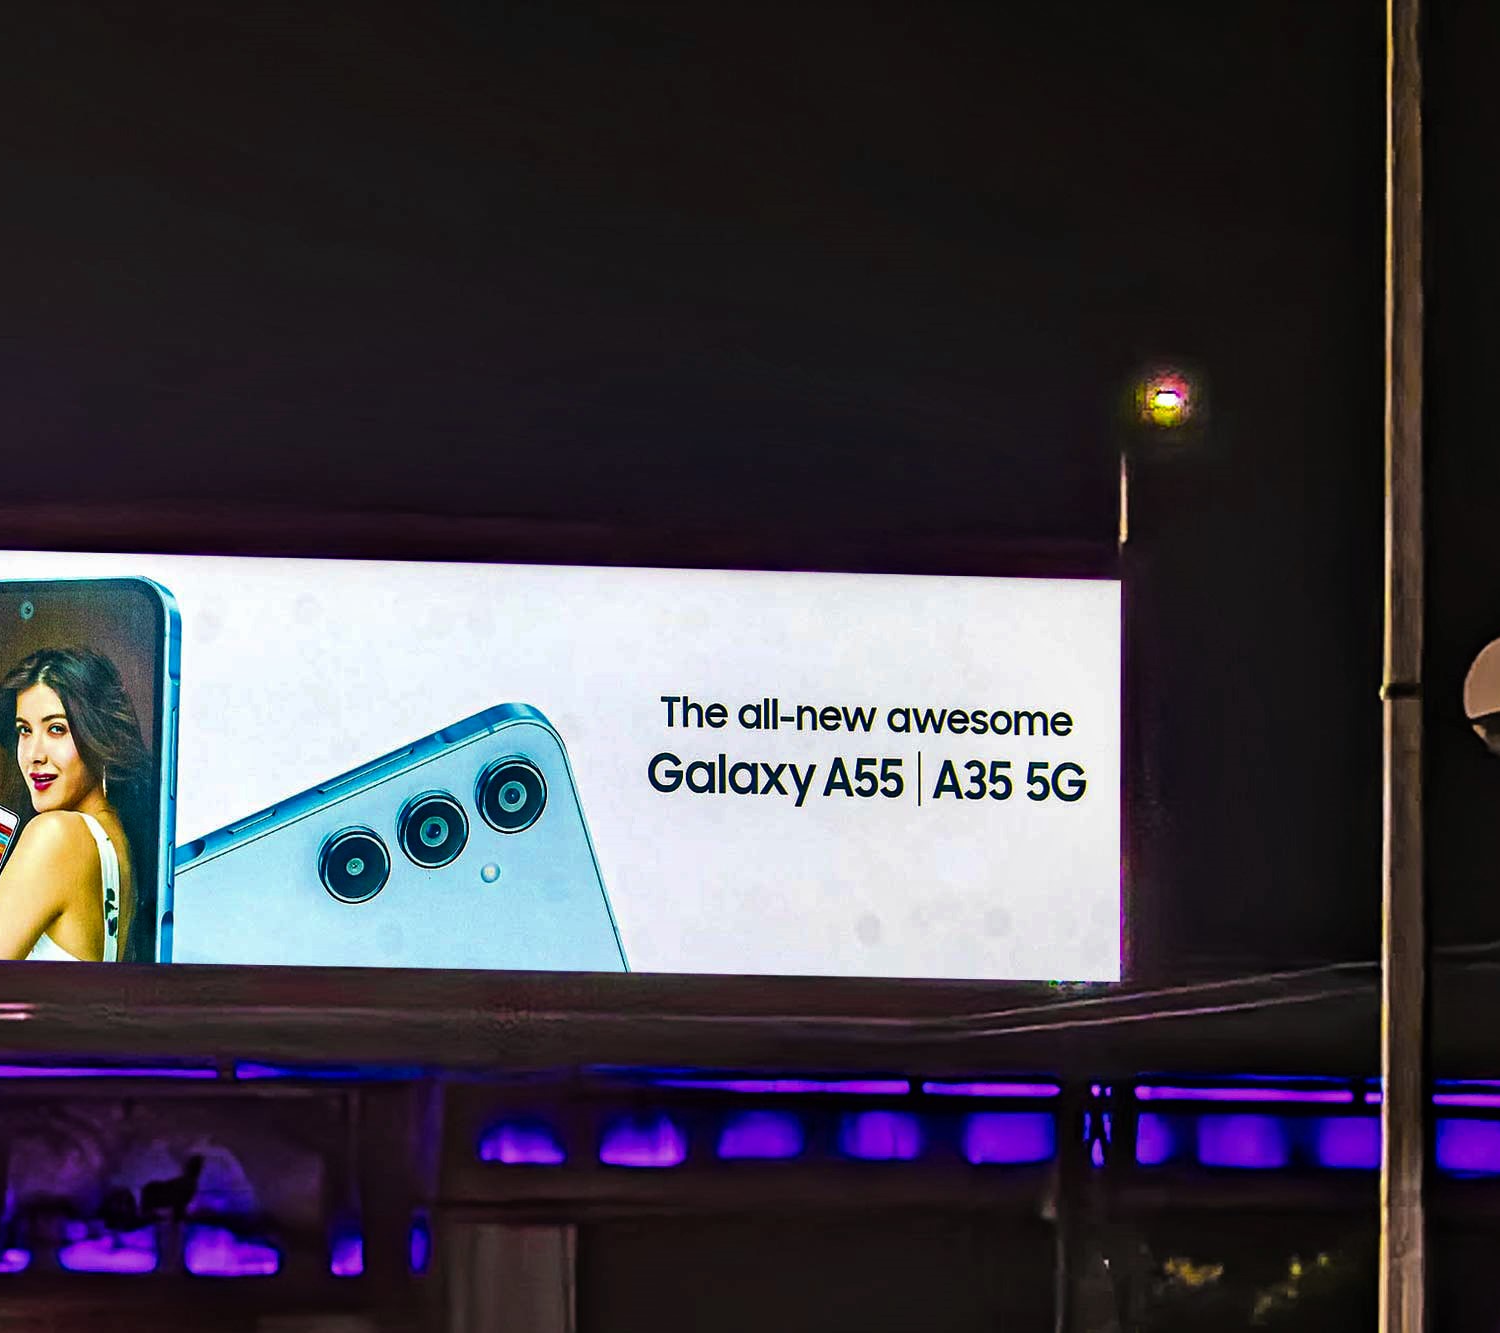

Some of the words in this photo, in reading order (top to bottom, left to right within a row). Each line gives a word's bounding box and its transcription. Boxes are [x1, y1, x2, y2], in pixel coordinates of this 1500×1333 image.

[660, 696, 728, 729] The
[737, 697, 877, 733] all-new
[886, 706, 1074, 737] awesome
[647, 752, 817, 808] Galaxy
[822, 756, 905, 799] A55
[932, 758, 1014, 802] A35
[1026, 761, 1087, 803] 5G
